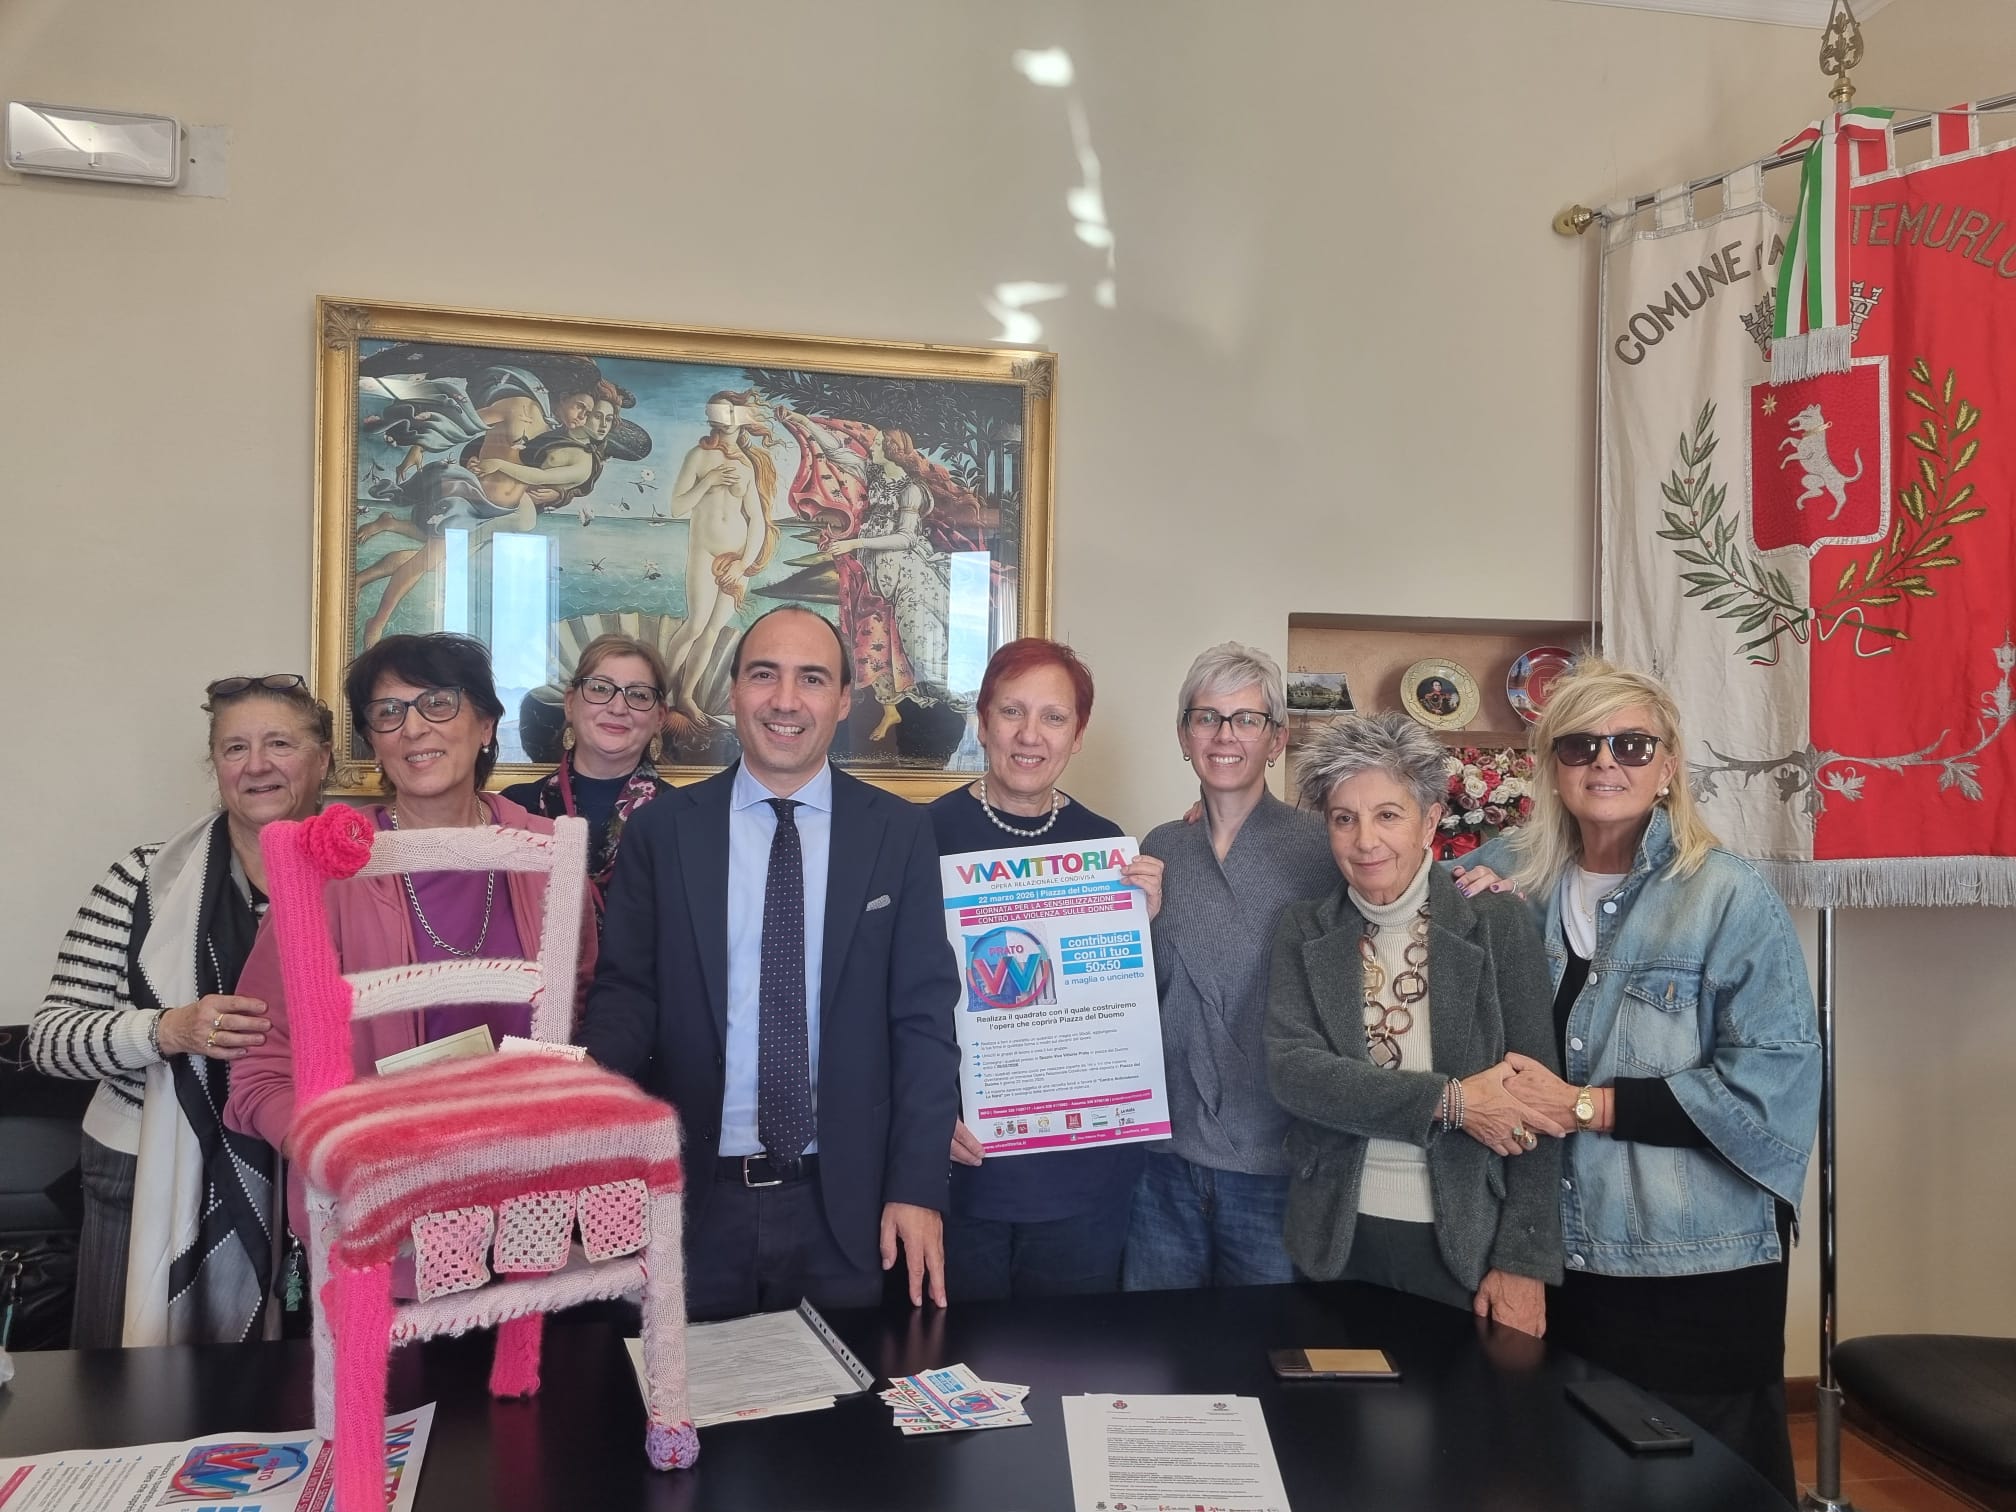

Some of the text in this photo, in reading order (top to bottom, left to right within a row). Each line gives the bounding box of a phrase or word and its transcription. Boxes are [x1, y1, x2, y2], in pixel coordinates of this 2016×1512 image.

[1615, 240, 1751, 365] COMUNE
[1014, 878, 1058, 888] RELAZIONALE
[1061, 874, 1095, 884] CONDIVISA
[990, 894, 1014, 903] marzo
[1016, 892, 1034, 901] 2026
[1040, 888, 1066, 897] Piazza
[1082, 884, 1110, 893] Duomo
[975, 905, 1012, 915] GIORNATA
[1044, 894, 1114, 908] SENSIBILIZZAZIONE
[978, 915, 1008, 924] CONTRO
[1024, 909, 1060, 920] VIOLENZA
[1063, 906, 1085, 915] SULLE
[1088, 904, 1114, 913] DONNE
[1068, 932, 1133, 947] contribuisci
[989, 944, 1024, 955] PRATO
[1074, 947, 1129, 960] con il tuo
[1085, 960, 1120, 973] 50x50
[1071, 975, 1098, 986] maglia
[1107, 971, 1144, 982] uncinetto
[976, 1014, 1007, 1023] Realizza
[1009, 1013, 1013, 1021] il
[1015, 1010, 1047, 1021] quadrato
[1049, 1009, 1062, 1017] con
[1071, 1006, 1090, 1016] quale
[1092, 1002, 1137, 1012] costruiremo
[990, 1011, 1125, 1031] l'opera che coprirà Piazza del Duomo
